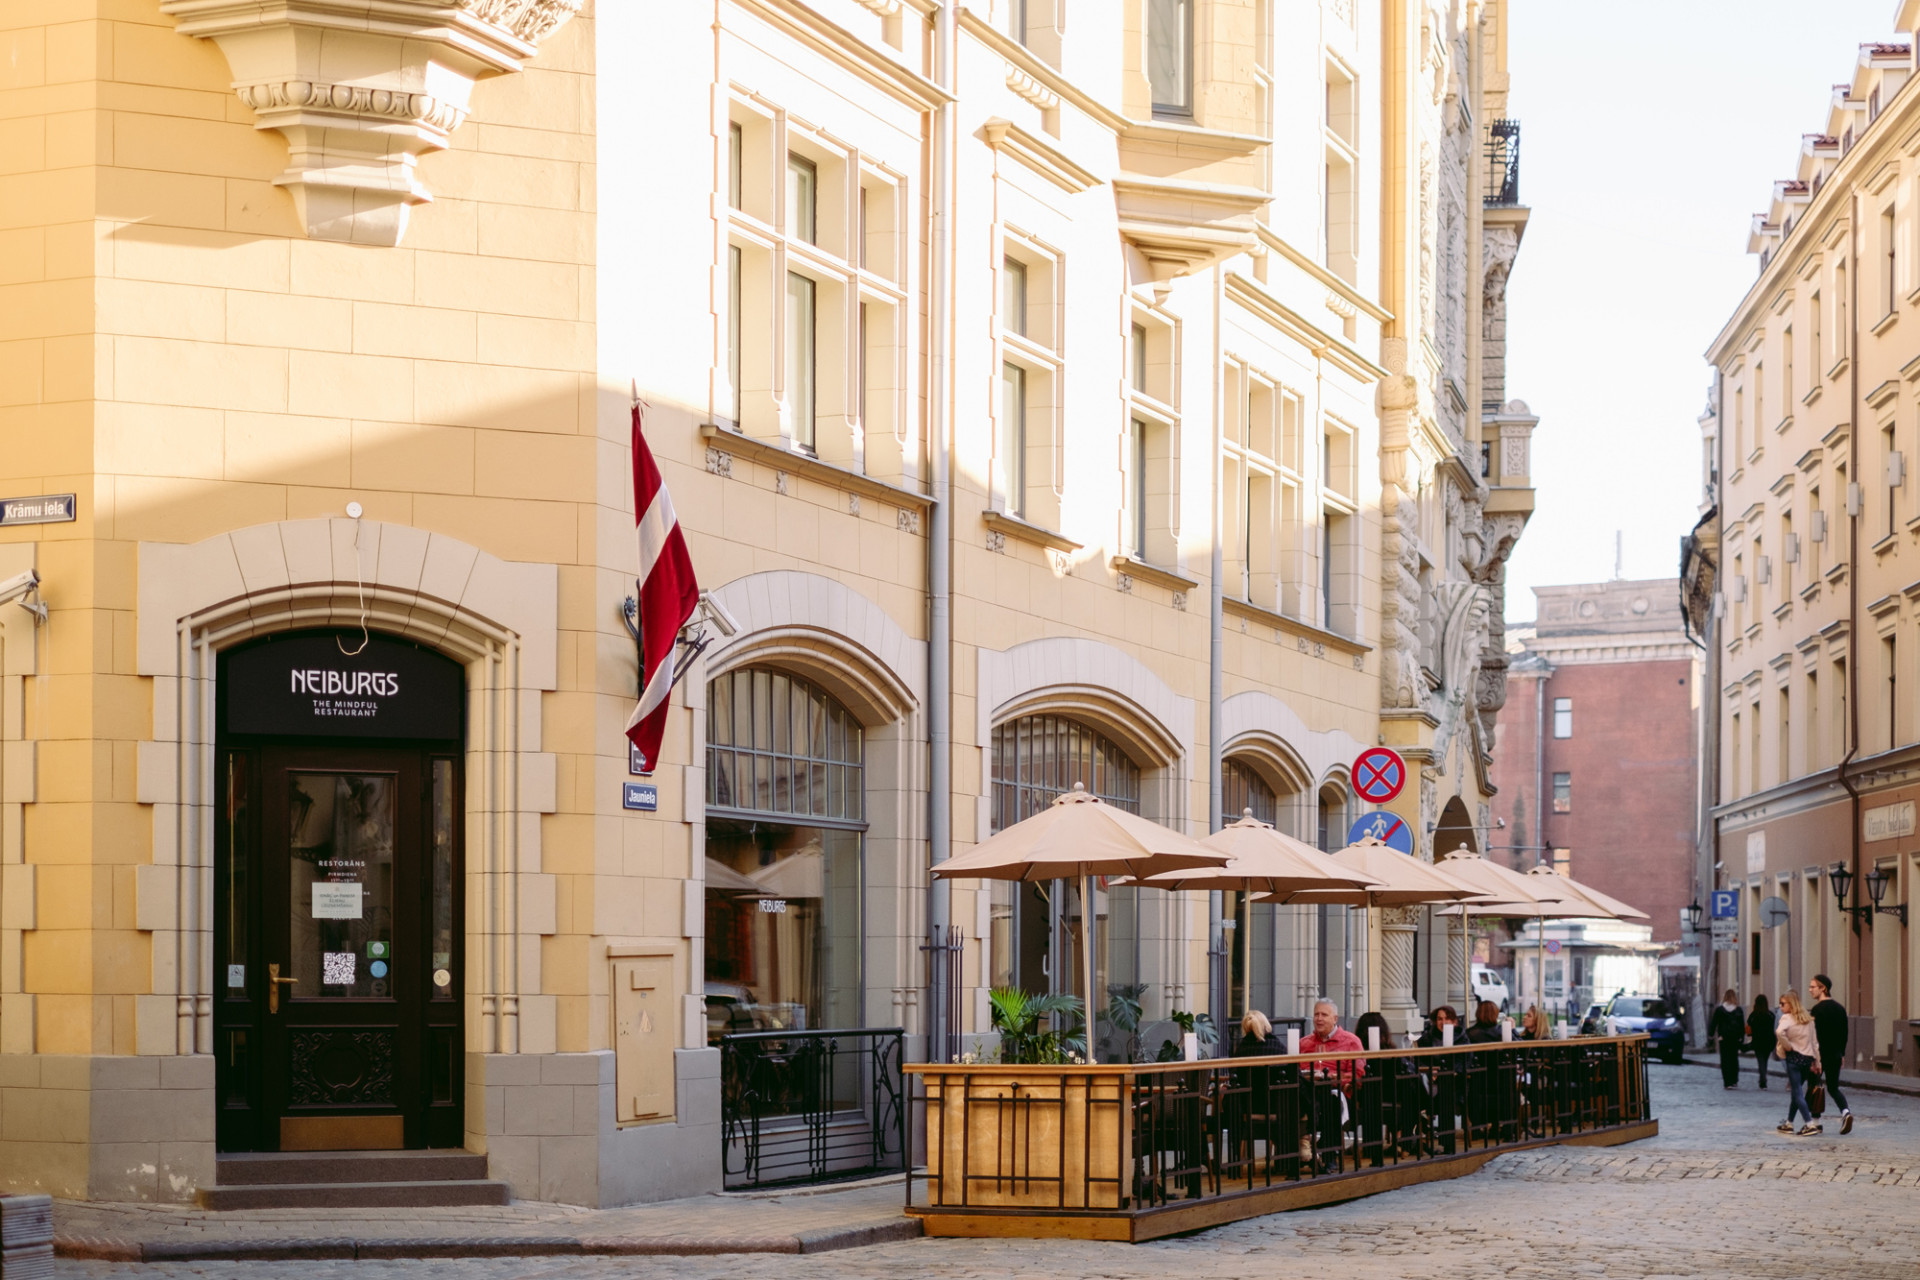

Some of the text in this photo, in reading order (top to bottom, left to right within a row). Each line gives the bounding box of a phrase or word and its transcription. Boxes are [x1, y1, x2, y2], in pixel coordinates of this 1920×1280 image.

[5, 501, 64, 519] Krāmu iela
[291, 669, 399, 696] NEIBURGS
[313, 700, 378, 709] THE MINDFUL
[314, 708, 377, 717] RESTAURANT
[628, 789, 656, 805] Jauniela
[758, 899, 787, 913] NEIBURGS
[1716, 893, 1733, 915] P
